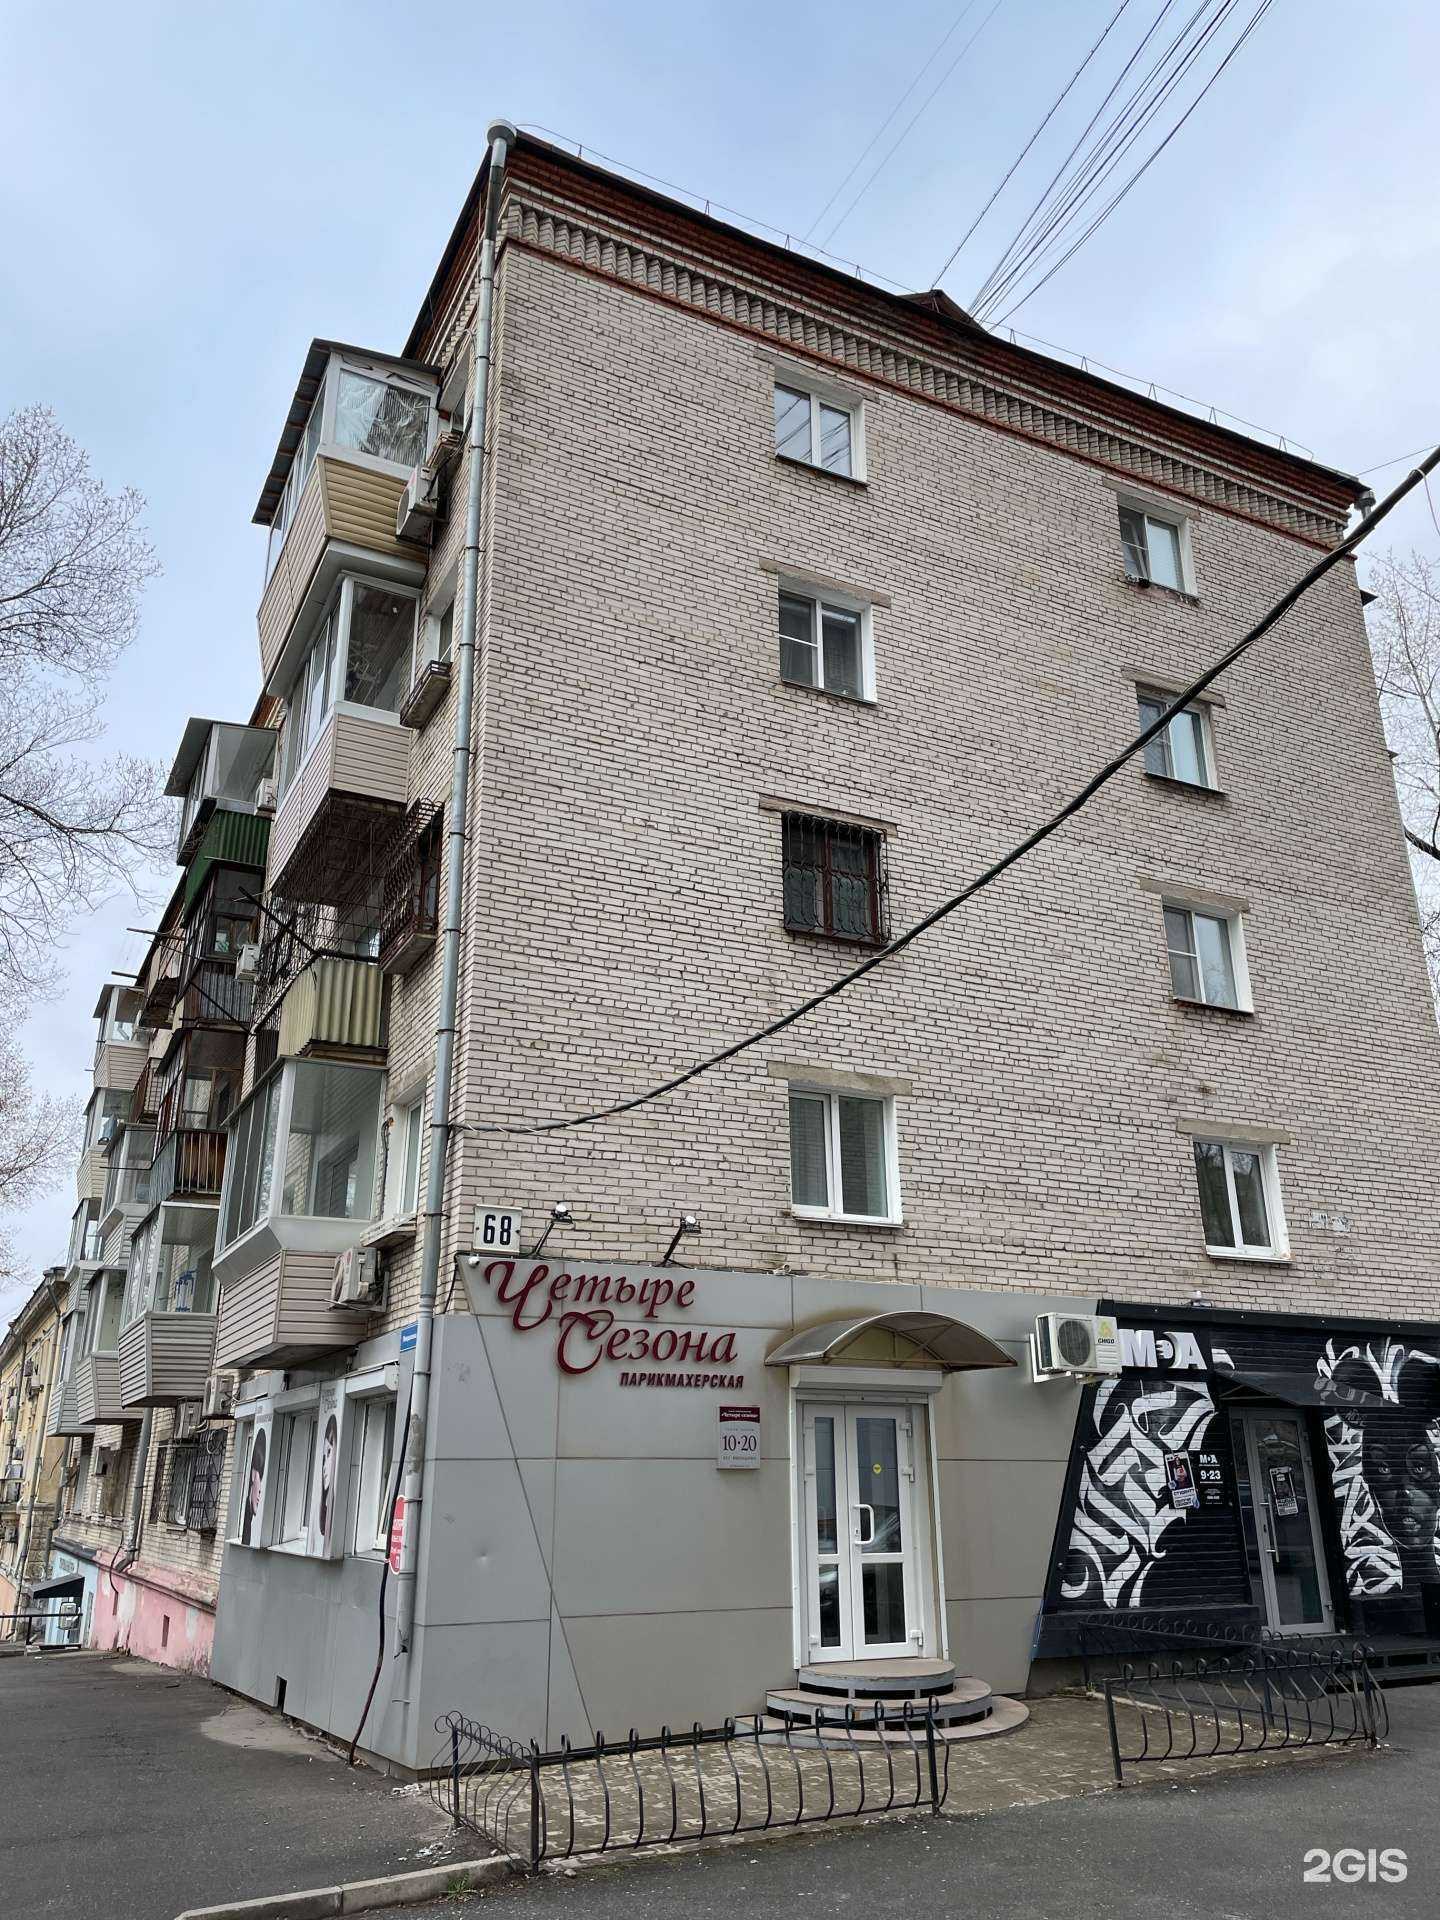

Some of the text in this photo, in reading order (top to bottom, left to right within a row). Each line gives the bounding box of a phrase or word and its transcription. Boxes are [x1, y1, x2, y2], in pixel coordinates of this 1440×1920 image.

[483, 1213, 512, 1246] 68
[484, 1260, 696, 1331] Четыре
[557, 1309, 738, 1375] Сезона
[619, 1371, 744, 1389] ПАРИКМАХЕРСКАЯ
